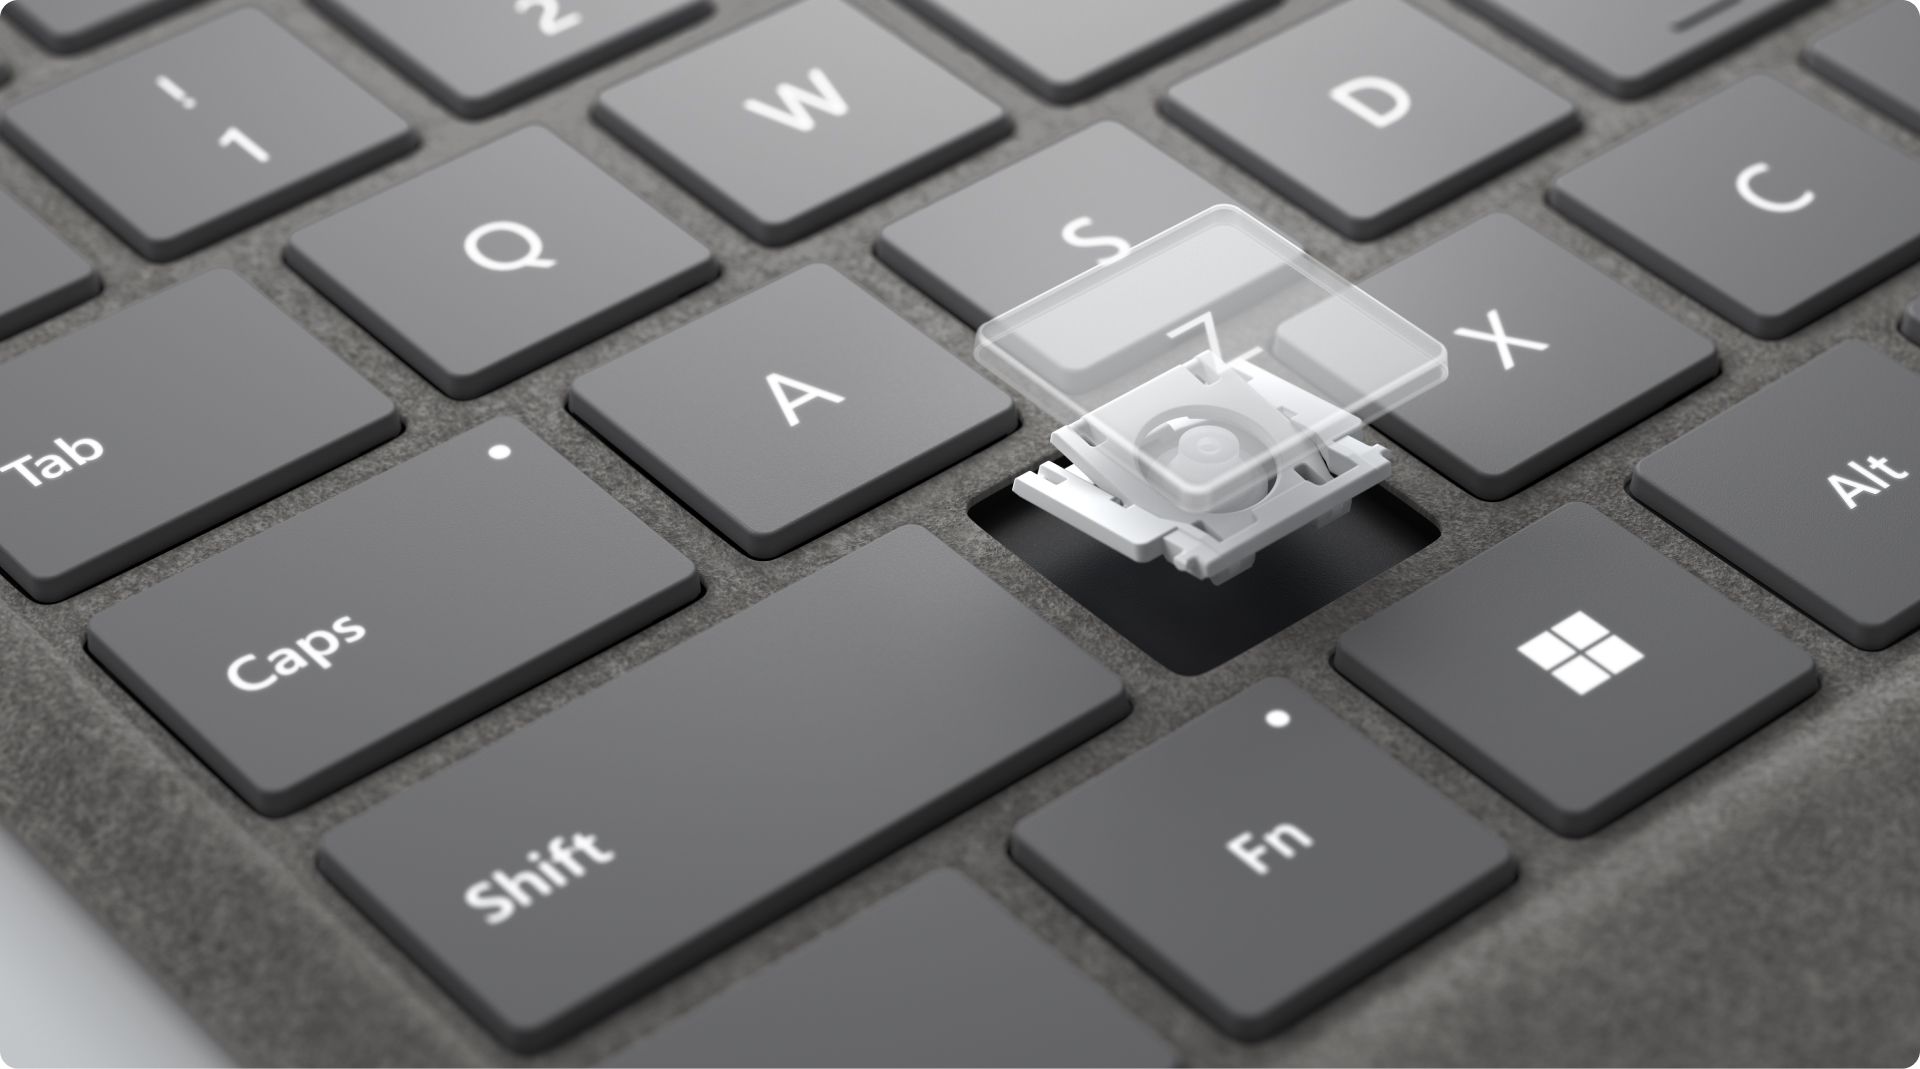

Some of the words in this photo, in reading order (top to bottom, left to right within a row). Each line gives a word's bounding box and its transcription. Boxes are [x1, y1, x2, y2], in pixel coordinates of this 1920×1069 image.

[515, 0, 582, 36] 2
[155, 75, 197, 110] !
[743, 67, 851, 133] W
[1329, 75, 1412, 129] D
[217, 126, 271, 164] 1
[1735, 161, 1816, 214] C
[463, 220, 557, 272] Q
[1061, 215, 1132, 266] S
[1166, 311, 1263, 374] Z
[1453, 308, 1550, 371] X
[764, 372, 846, 427] A
[0, 432, 104, 488] Tab
[1826, 453, 1909, 510] Alt
[226, 608, 367, 695] Caps
[1226, 816, 1314, 875] Fn
[463, 827, 615, 924] Shift
